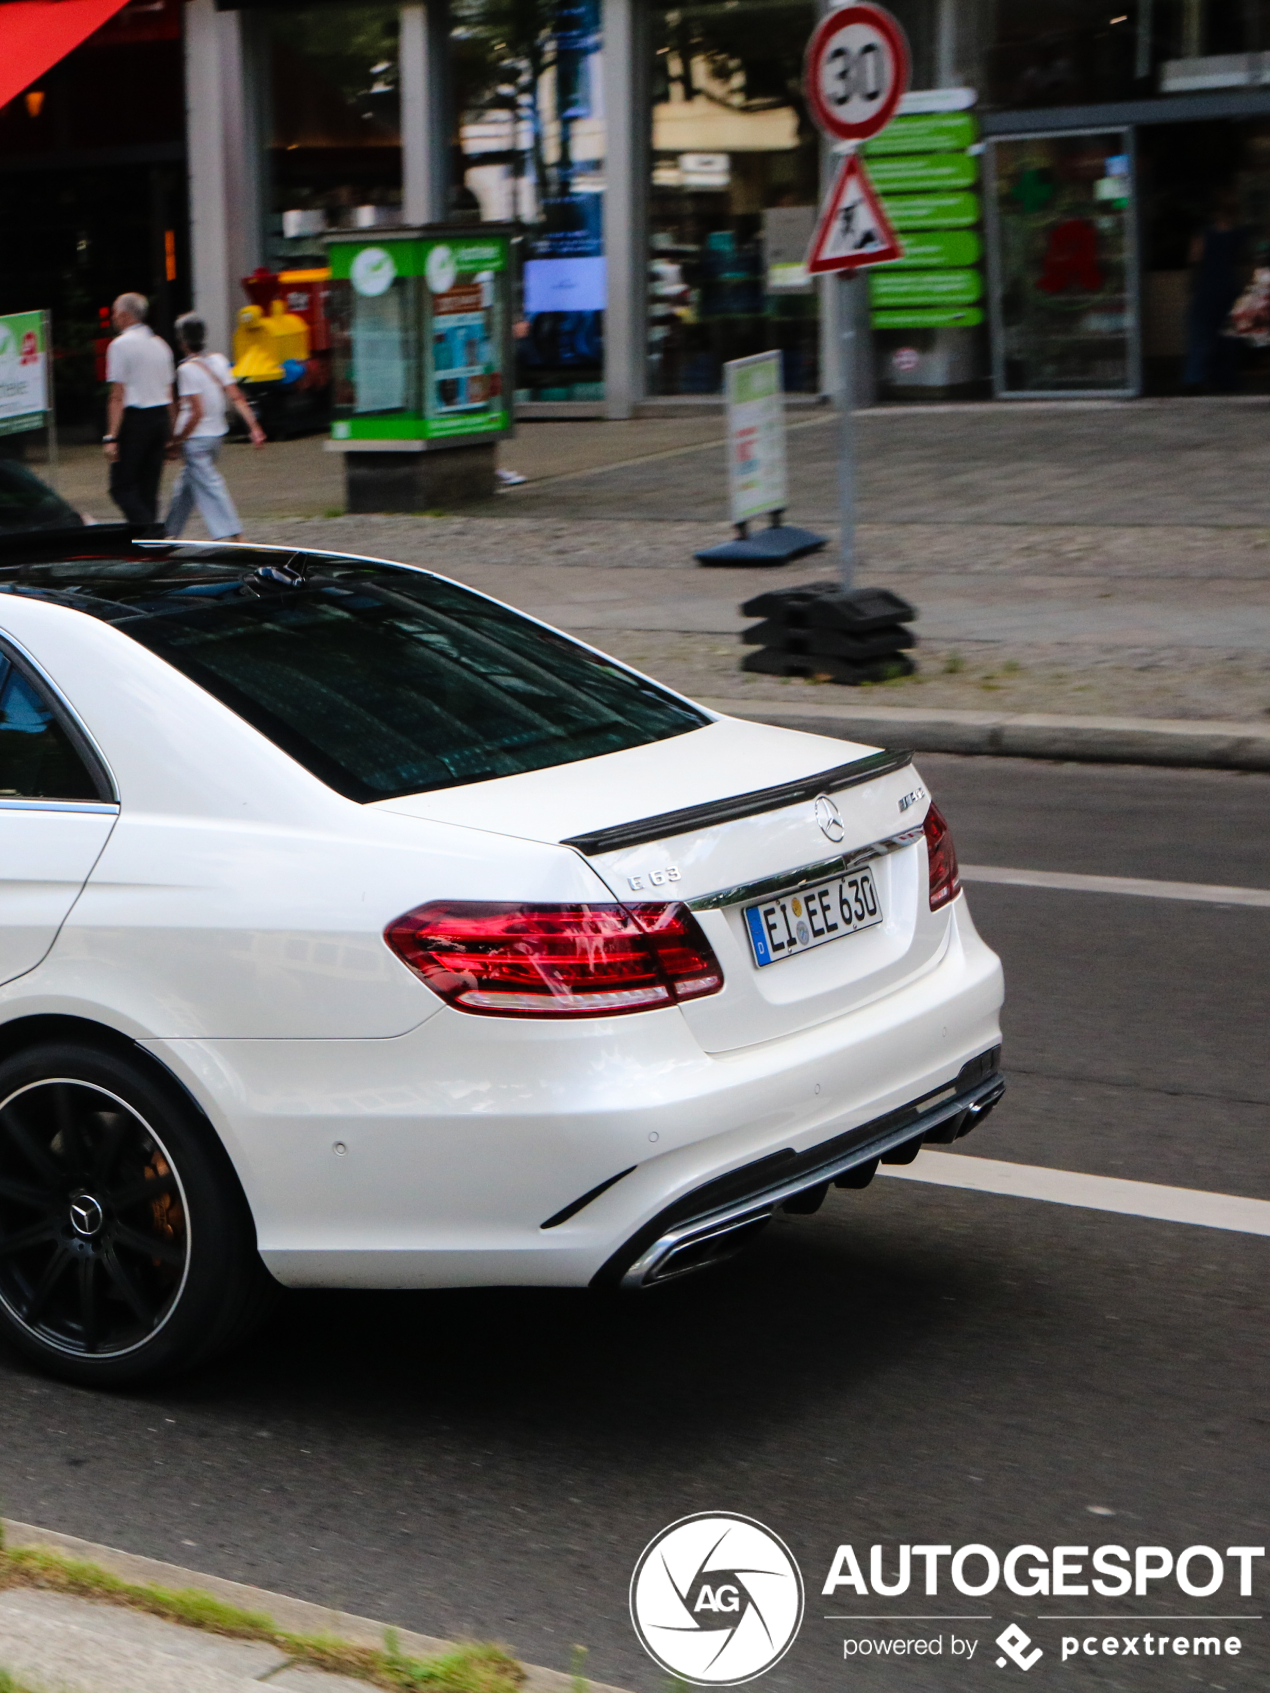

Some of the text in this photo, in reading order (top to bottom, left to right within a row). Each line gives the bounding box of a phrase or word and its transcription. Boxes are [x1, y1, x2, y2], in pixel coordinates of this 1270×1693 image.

[826, 42, 885, 106] 30
[627, 866, 681, 891] E 63
[763, 875, 877, 952] EI EE 630
[757, 942, 764, 954] D
